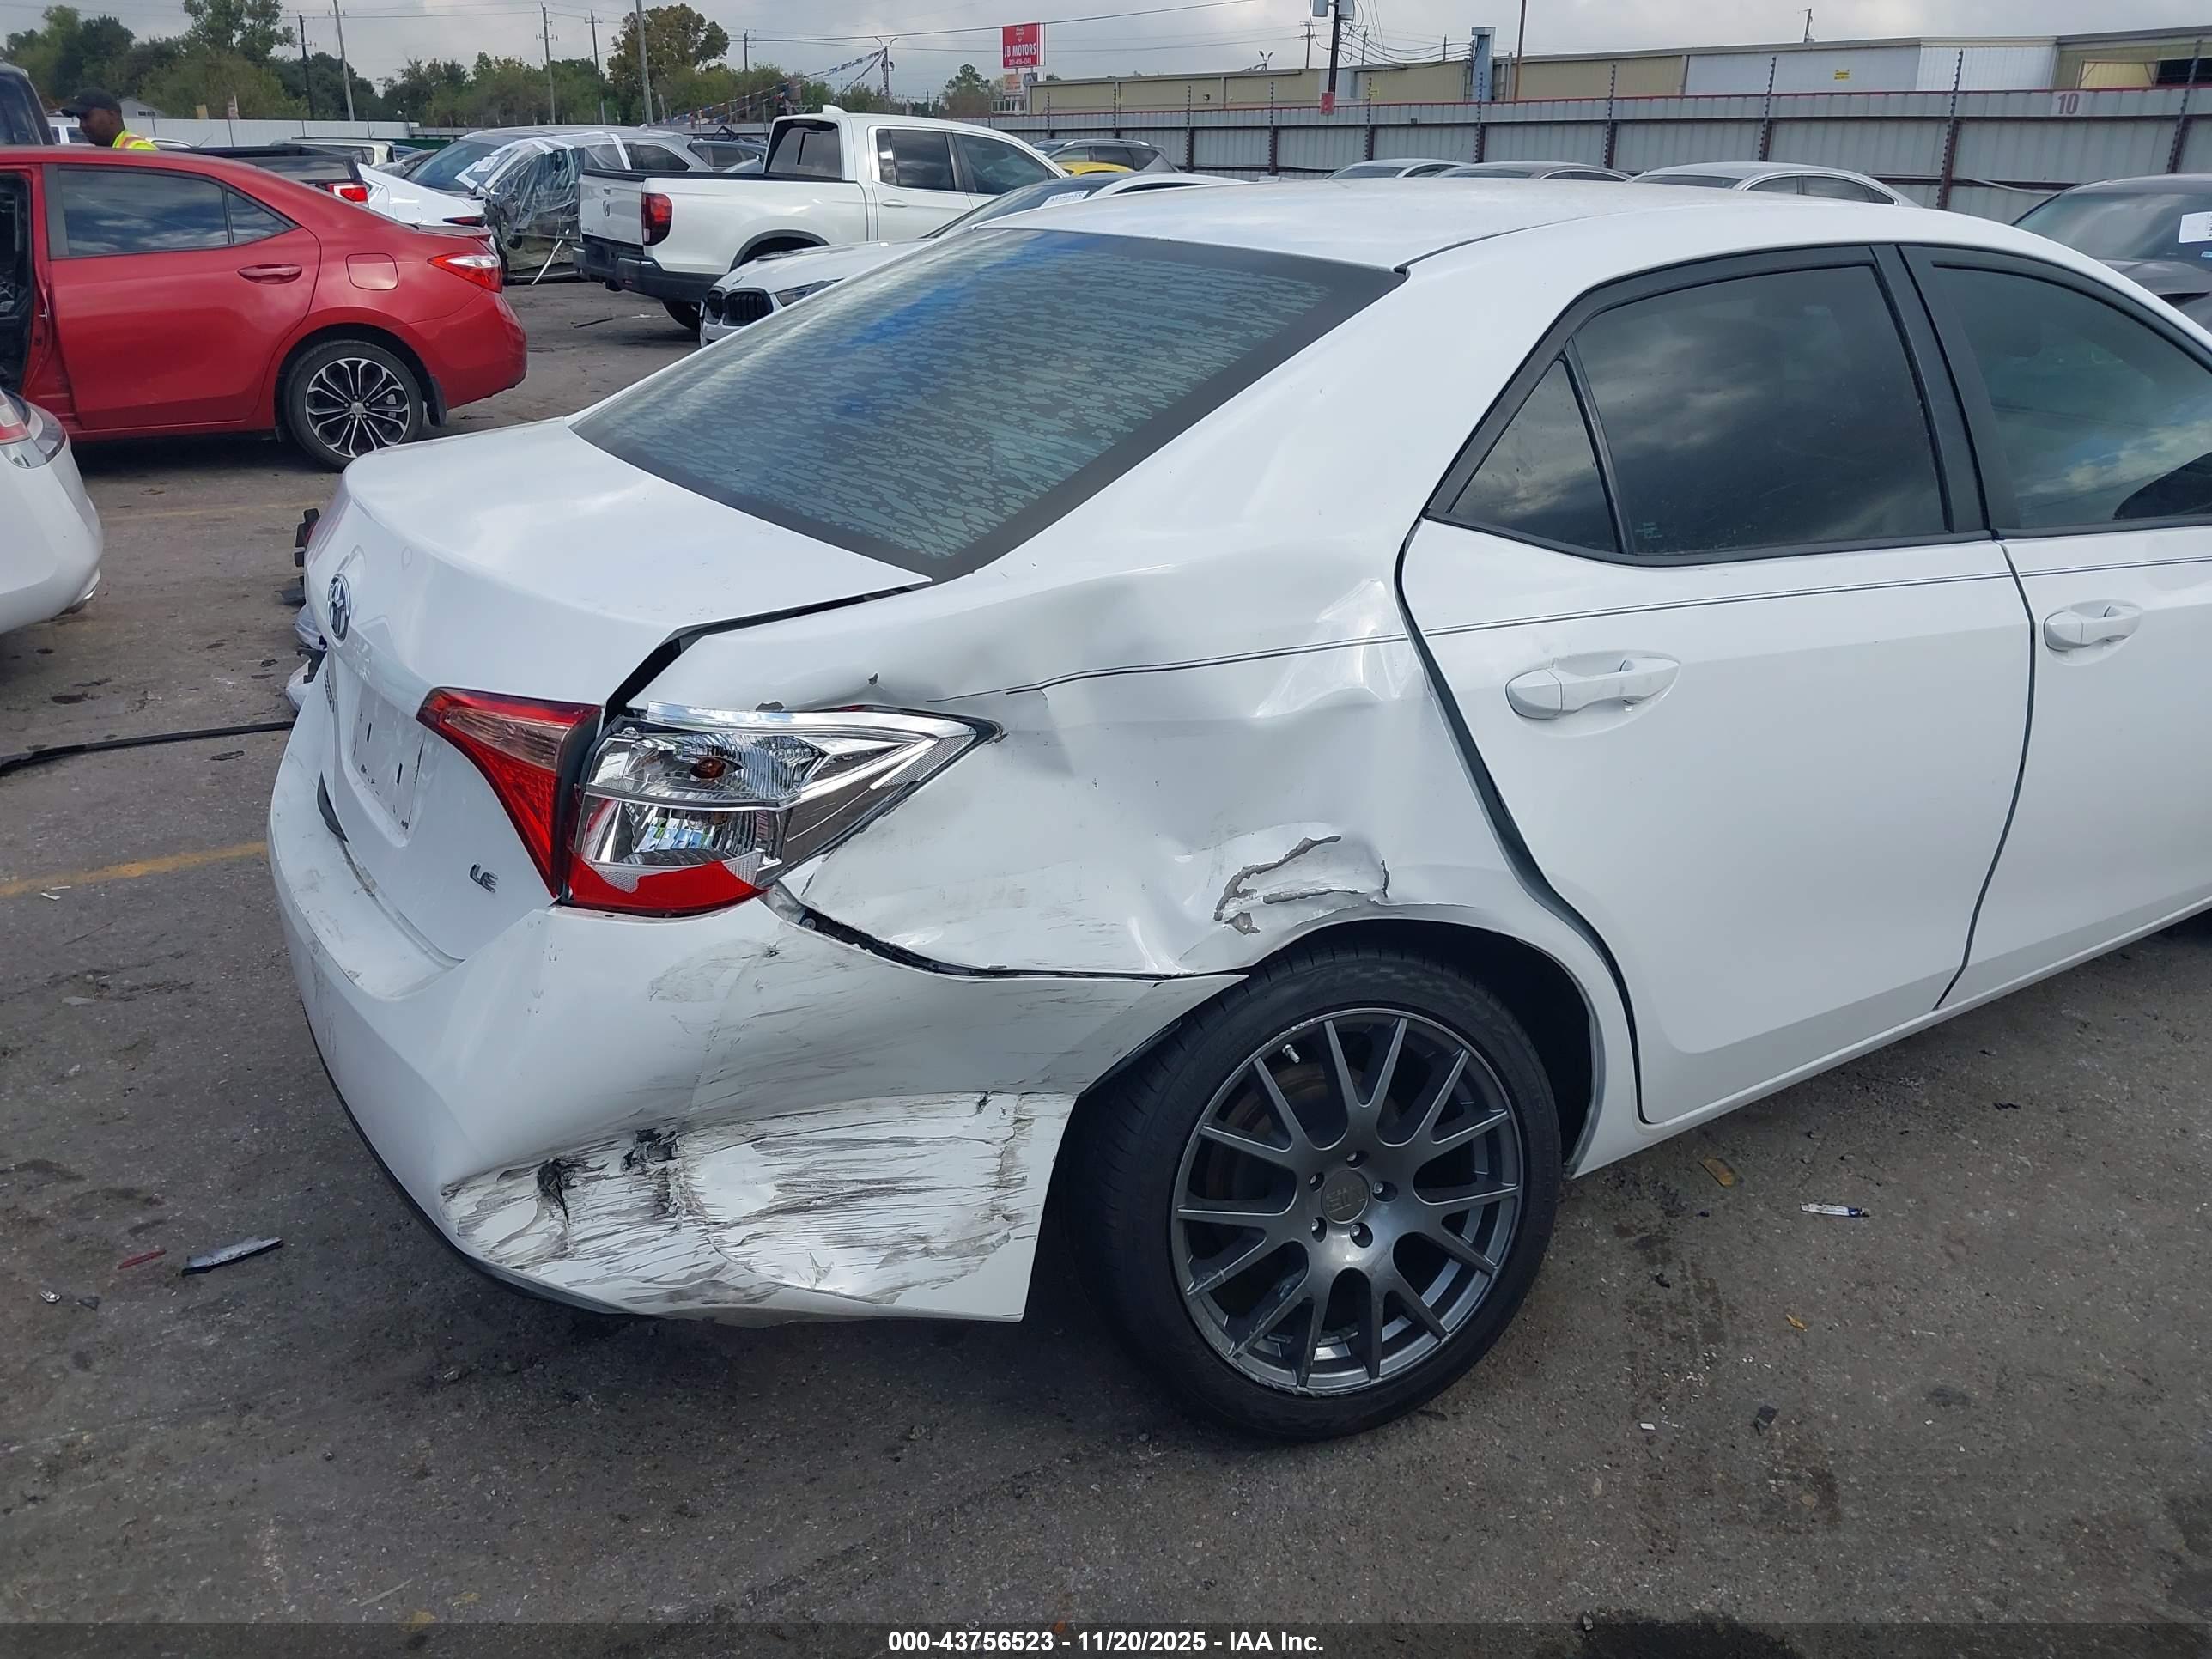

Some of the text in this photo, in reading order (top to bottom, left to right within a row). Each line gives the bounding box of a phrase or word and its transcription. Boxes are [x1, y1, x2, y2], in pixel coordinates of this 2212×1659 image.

[1004, 42, 1036, 58] JB MOTORS
[2057, 93, 2080, 115] 10
[469, 864, 499, 894] LE
